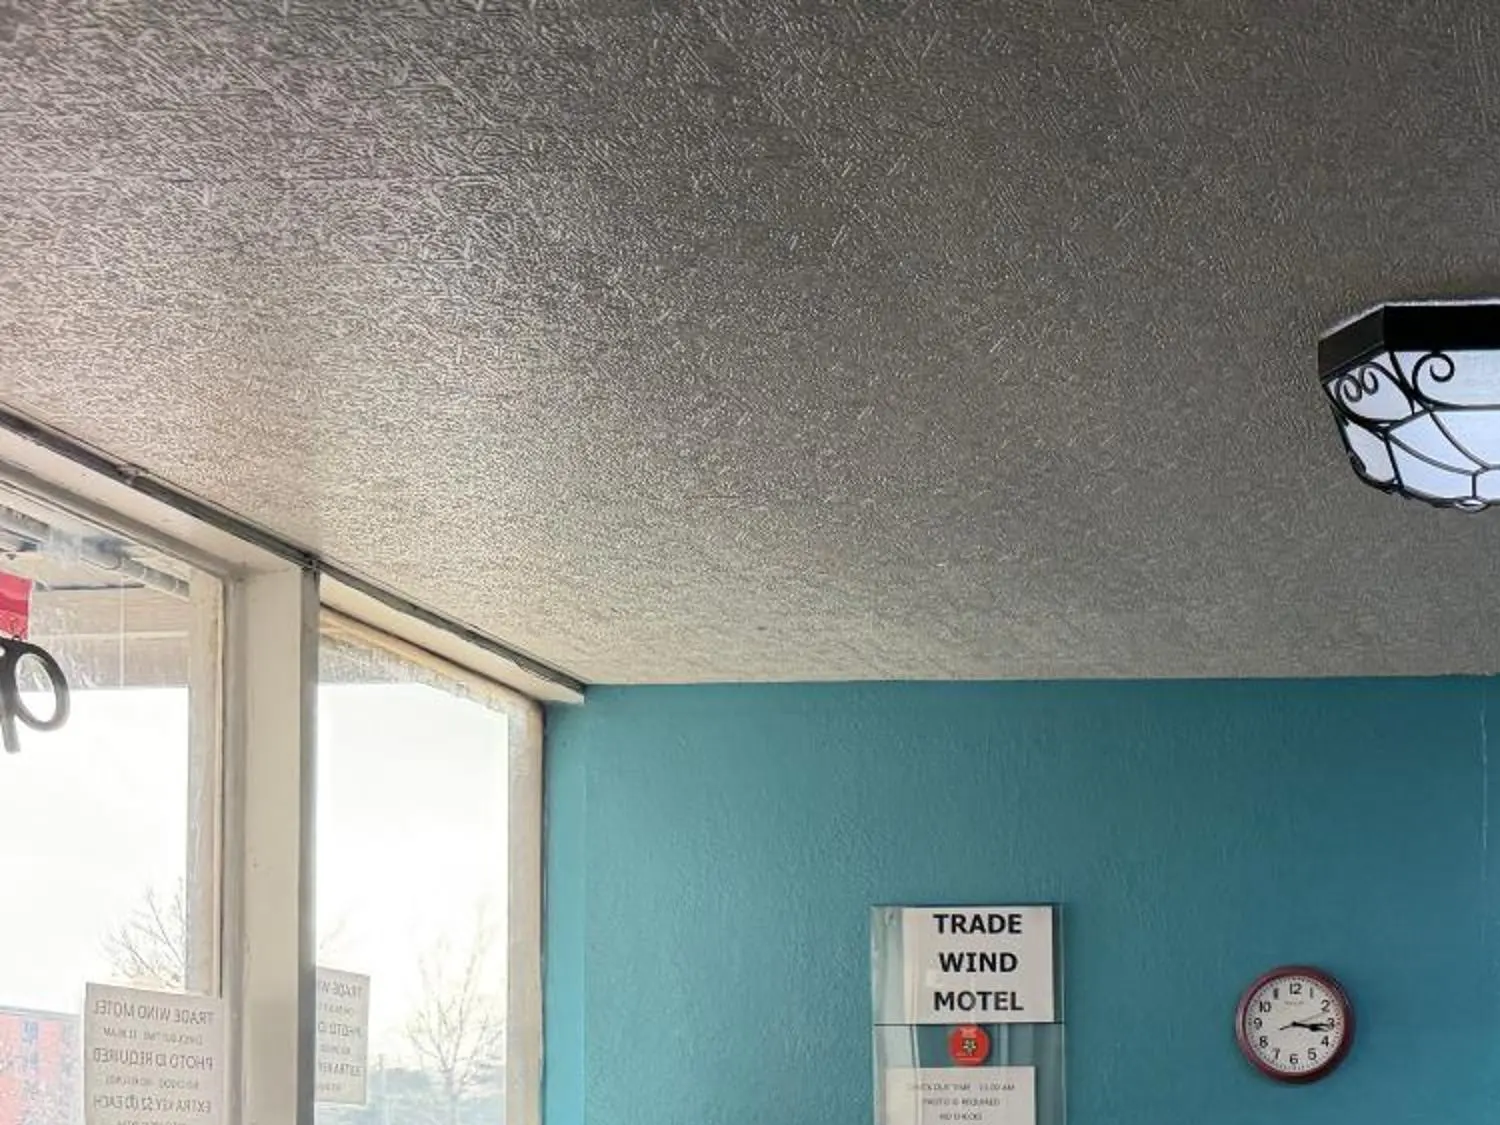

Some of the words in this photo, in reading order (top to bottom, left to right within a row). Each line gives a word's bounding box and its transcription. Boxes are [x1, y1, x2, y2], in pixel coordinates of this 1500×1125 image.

[932, 913, 1023, 935] TRADE
[938, 952, 1018, 973] WIND
[1289, 983, 1302, 995] 12
[933, 991, 1024, 1012] MOTEL
[1259, 1001, 1272, 1013] 10
[1321, 1000, 1330, 1013] 2
[1253, 1018, 1262, 1030] 9
[1328, 1018, 1336, 1029] 3
[1259, 1035, 1269, 1048] 8
[1321, 1036, 1329, 1047] 4
[1272, 1048, 1280, 1060] 7
[1289, 1053, 1298, 1065] 6
[1307, 1048, 1317, 1060] 5
